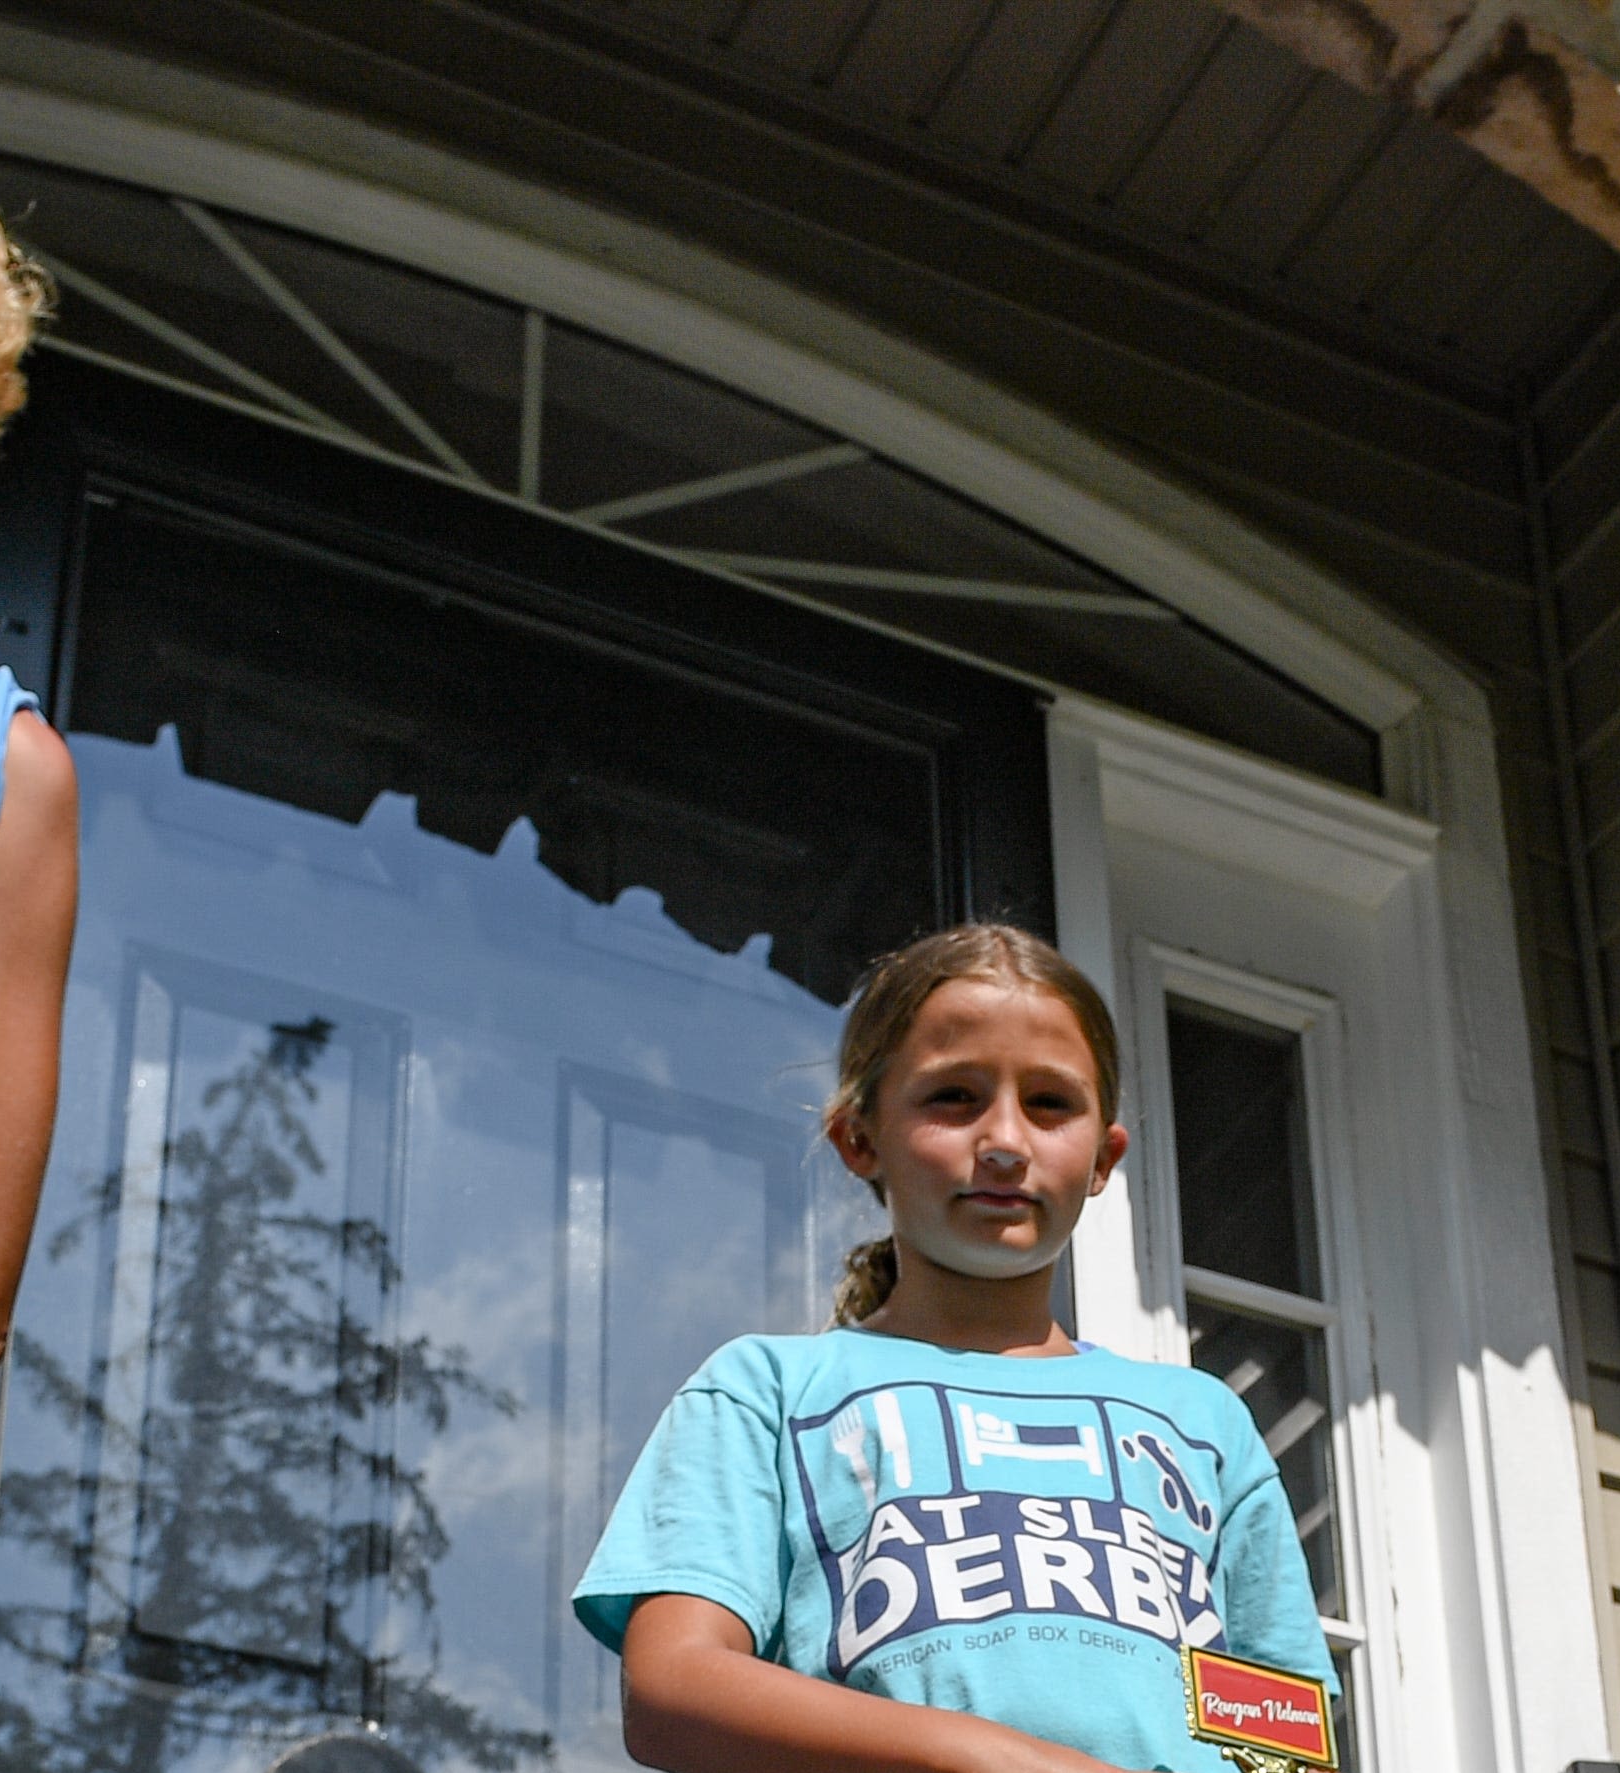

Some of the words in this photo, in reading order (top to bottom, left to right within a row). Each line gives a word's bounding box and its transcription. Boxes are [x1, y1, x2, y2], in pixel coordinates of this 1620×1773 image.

[837, 1533, 1223, 1669] DERBY
[863, 1636, 952, 1687] MERICAN
[963, 1627, 1018, 1652] SOAP
[1027, 1625, 1069, 1645] BOX
[1078, 1629, 1138, 1657] DERBY
